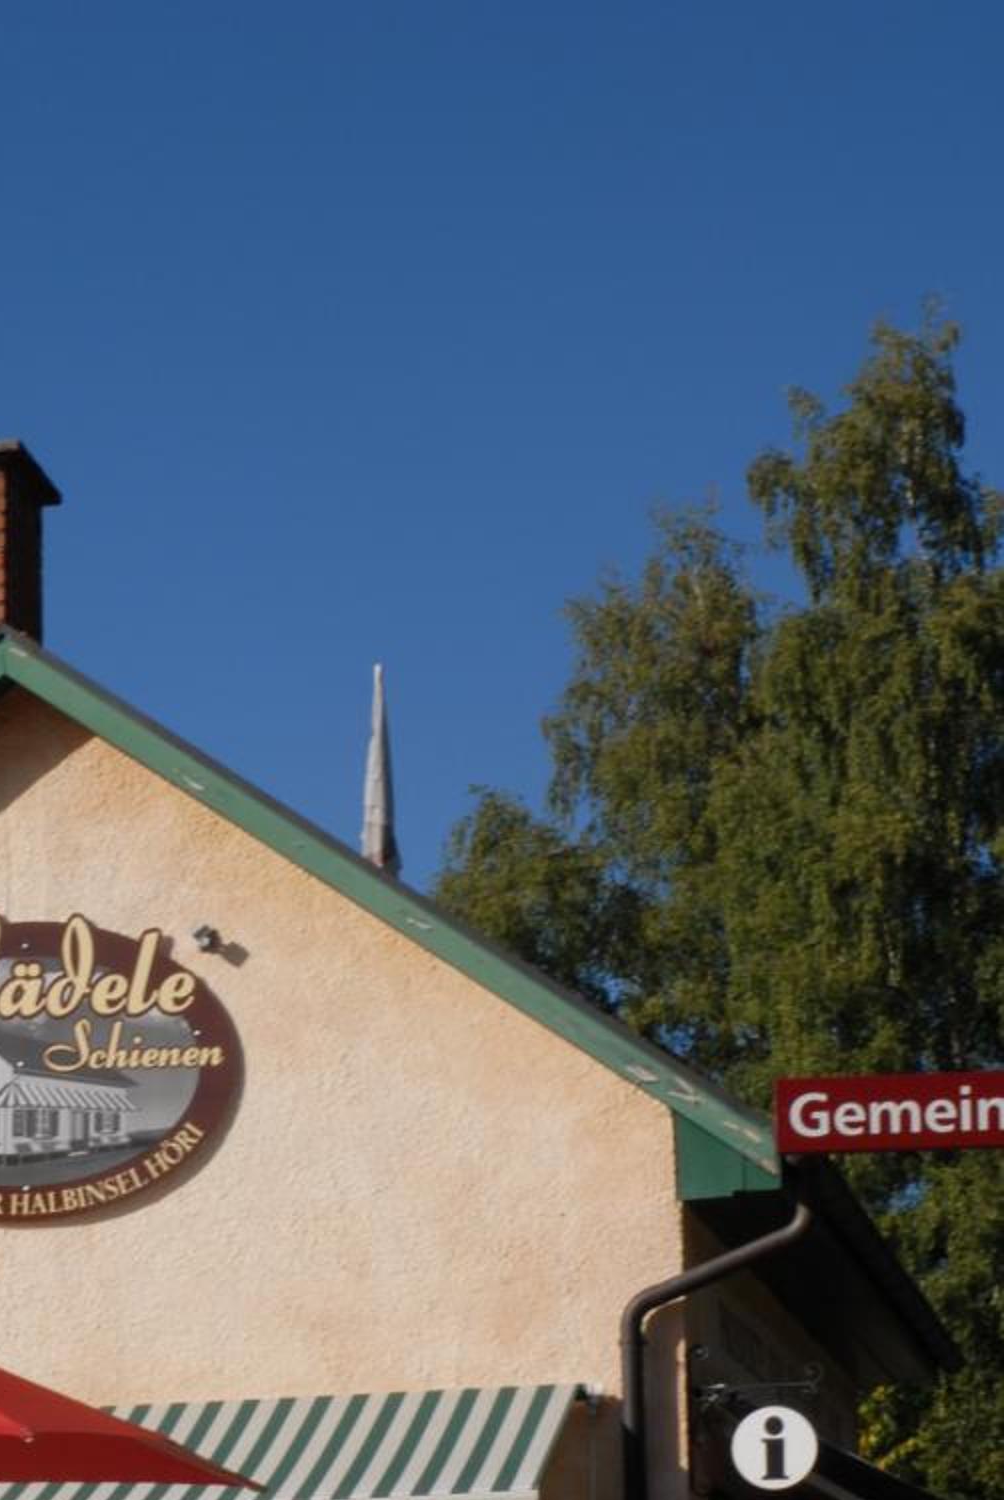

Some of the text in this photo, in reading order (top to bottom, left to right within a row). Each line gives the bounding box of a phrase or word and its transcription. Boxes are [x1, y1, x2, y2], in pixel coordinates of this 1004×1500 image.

[44, 1019, 225, 1073] Schienen
[788, 1085, 1004, 1138] Gemein
[10, 1166, 146, 1216] HALBINSEL
[144, 1121, 205, 1179] HÖRI
[761, 1415, 789, 1481] i
